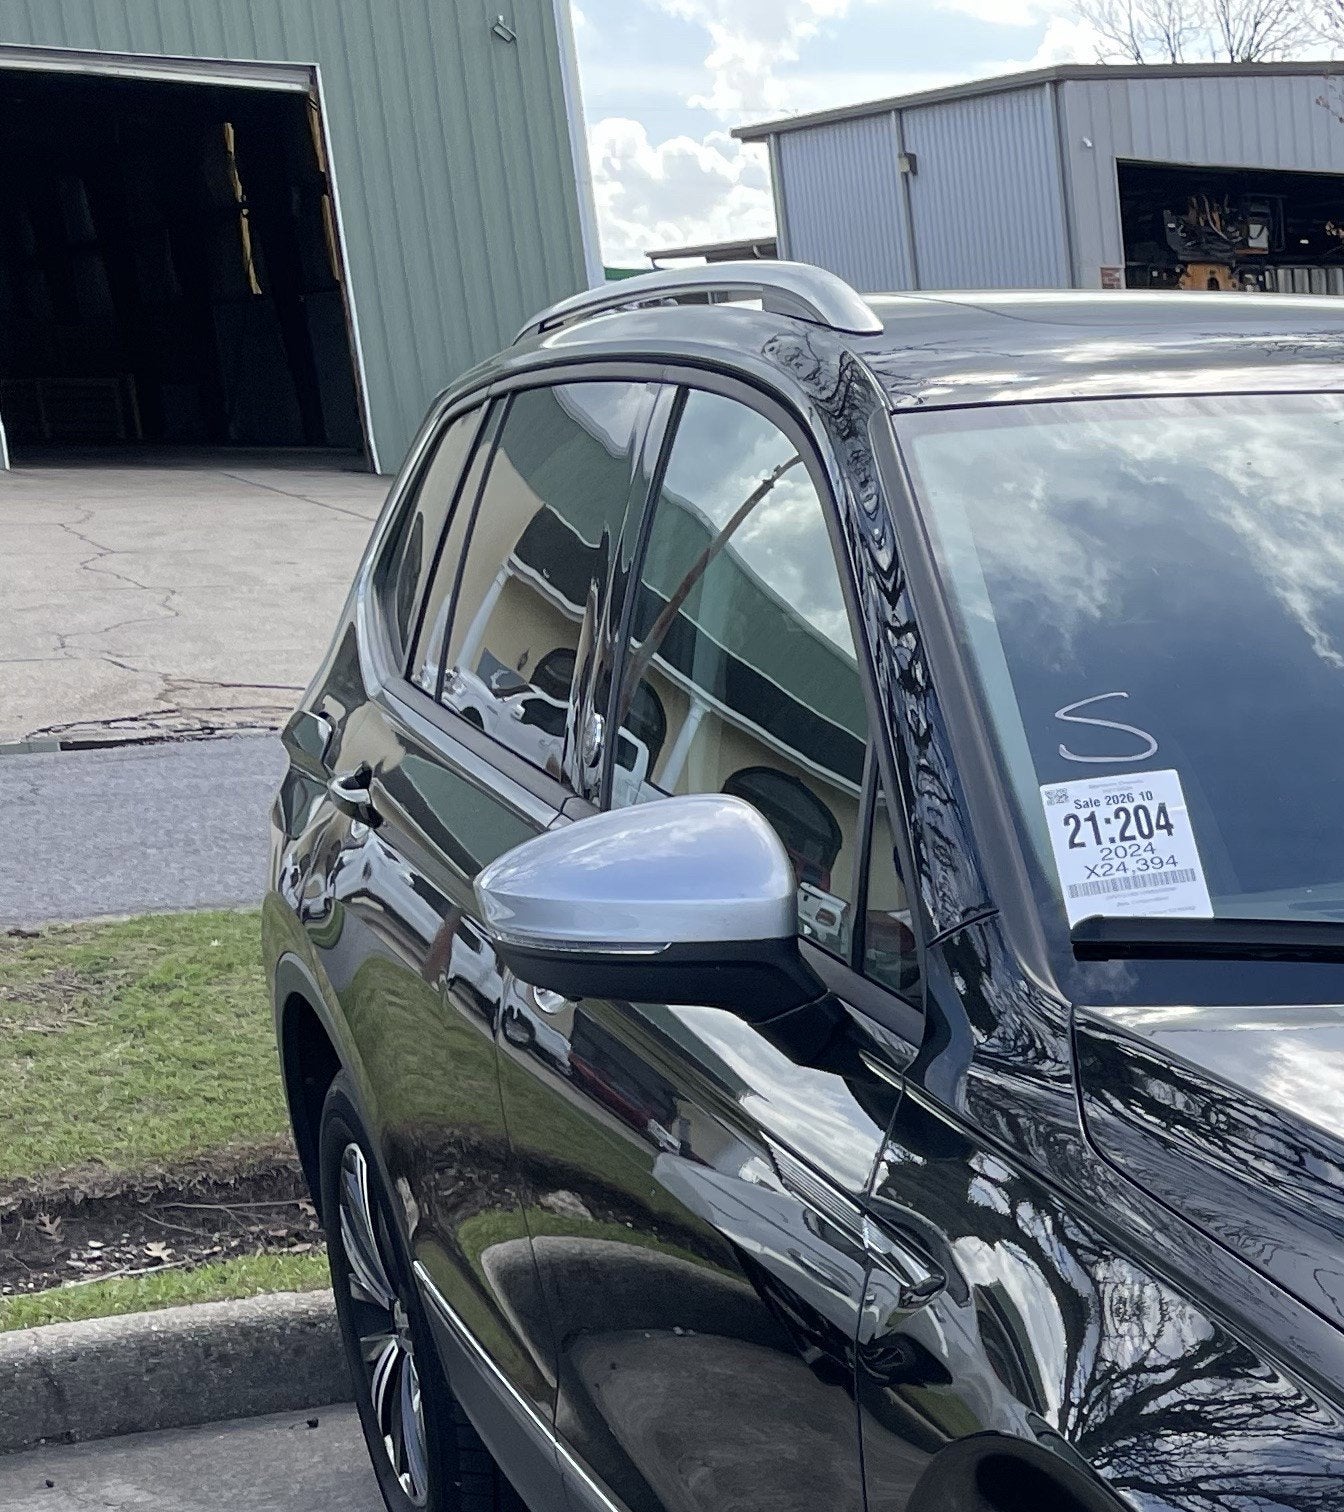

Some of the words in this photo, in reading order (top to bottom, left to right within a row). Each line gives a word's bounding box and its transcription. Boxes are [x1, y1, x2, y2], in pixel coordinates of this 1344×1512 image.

[1055, 691, 1158, 763] S
[1073, 796, 1102, 810] Sale
[1104, 792, 1135, 806] 2026
[1138, 790, 1154, 802] 10
[1063, 802, 1174, 849] 21:204
[1100, 842, 1156, 862] 2024
[1084, 854, 1179, 880] X24,394
